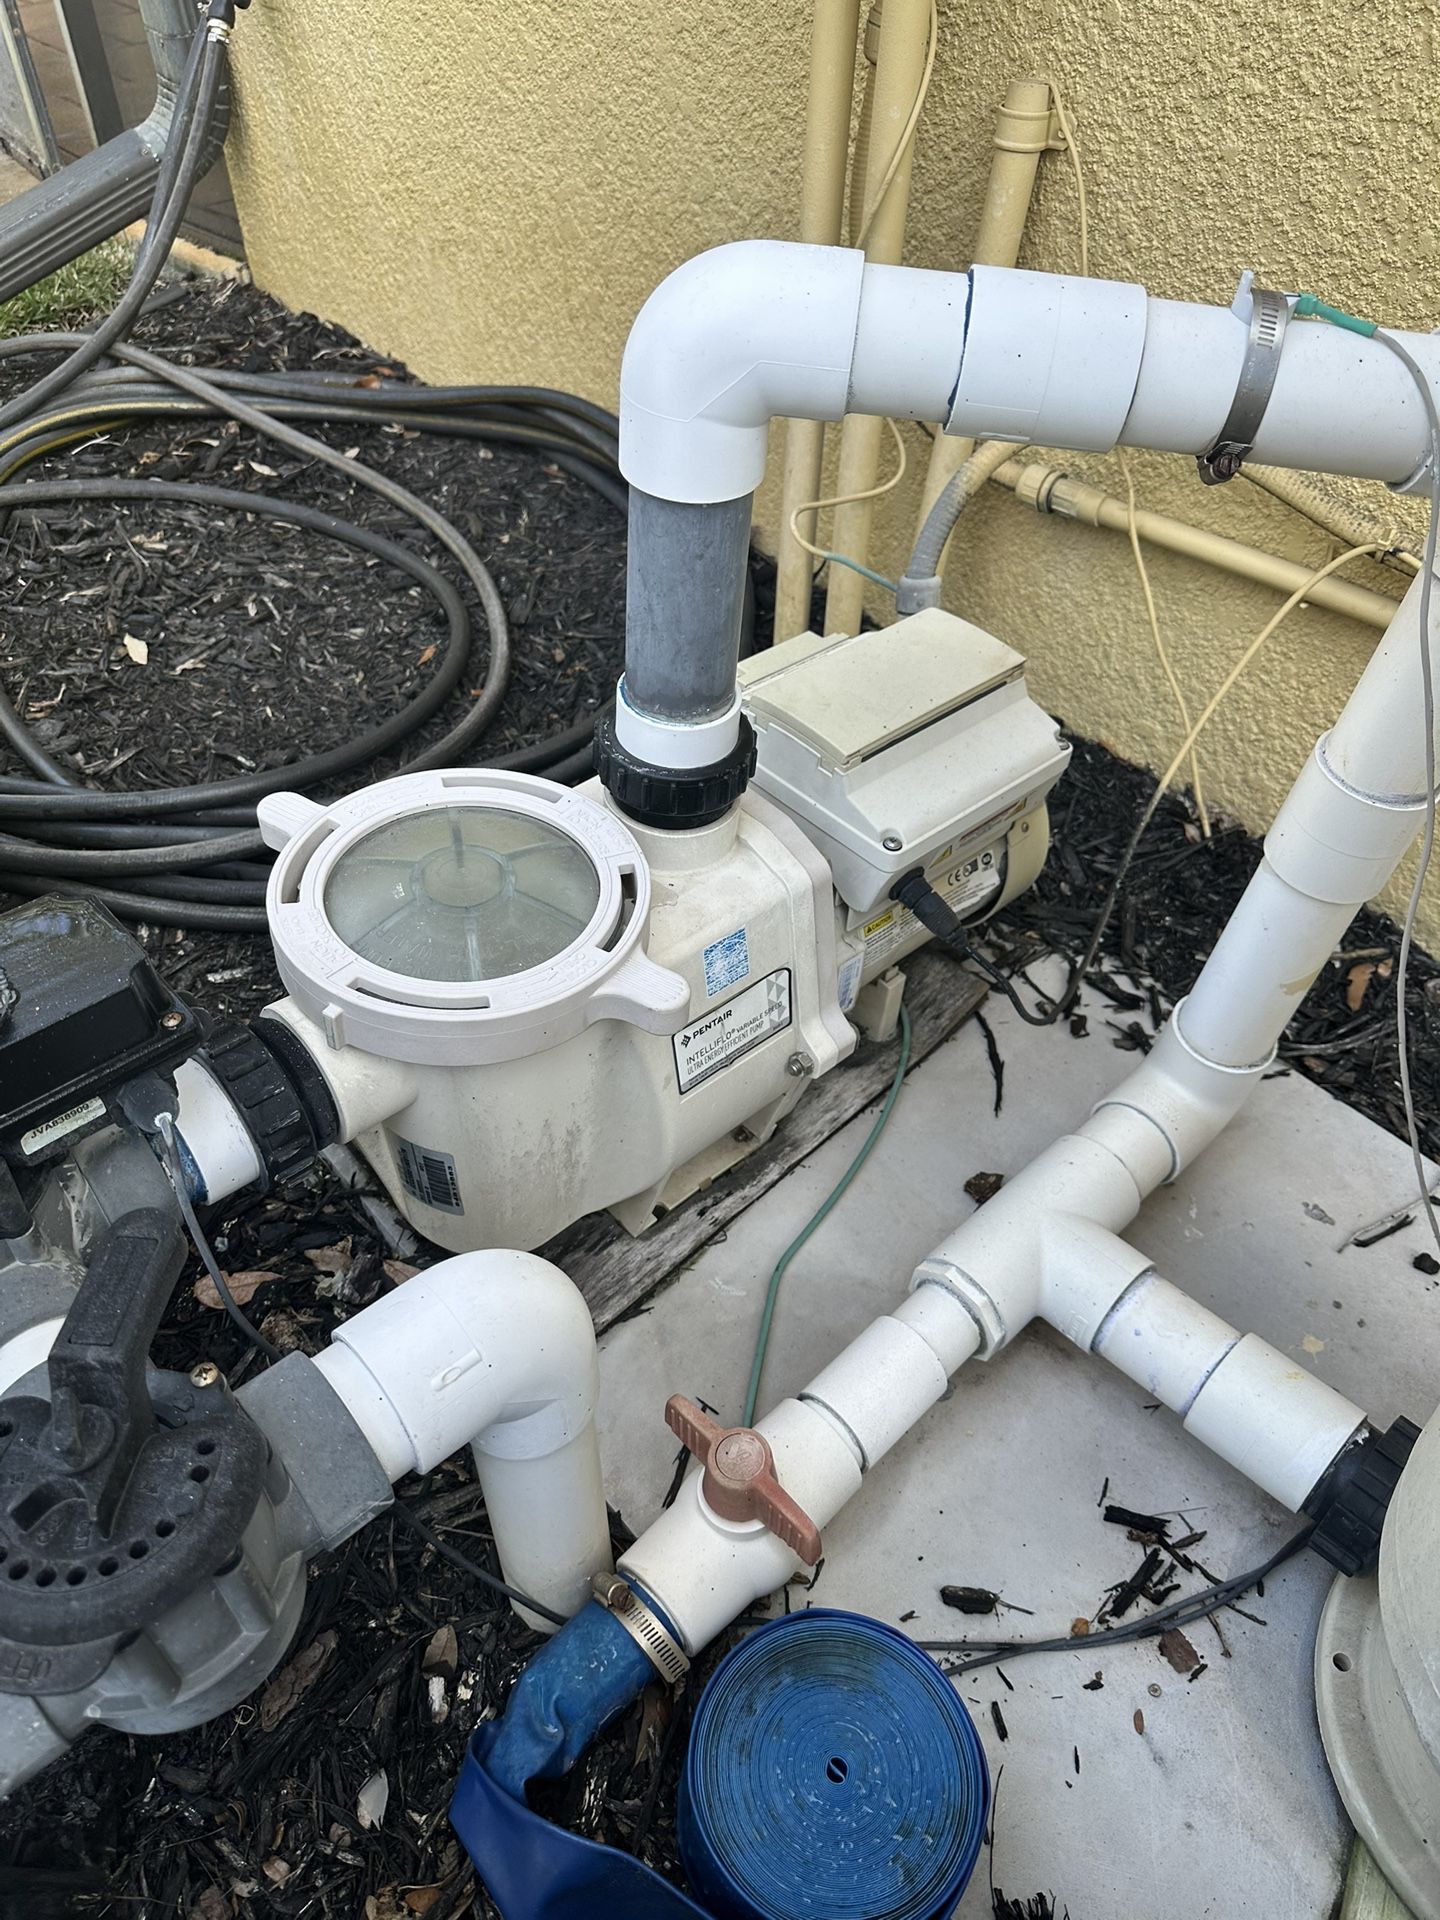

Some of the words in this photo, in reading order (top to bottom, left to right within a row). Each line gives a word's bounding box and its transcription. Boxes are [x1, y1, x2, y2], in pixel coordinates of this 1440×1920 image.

[692, 1009, 732, 1040] PENTAIR
[736, 1012, 763, 1033] VARIABLE
[764, 1001, 783, 1017] SPEED
[688, 1059, 704, 1076] ULTRA
[704, 1045, 724, 1065] ENERGY
[725, 1029, 749, 1052] EFFICIENT
[750, 1019, 764, 1036] PUMP
